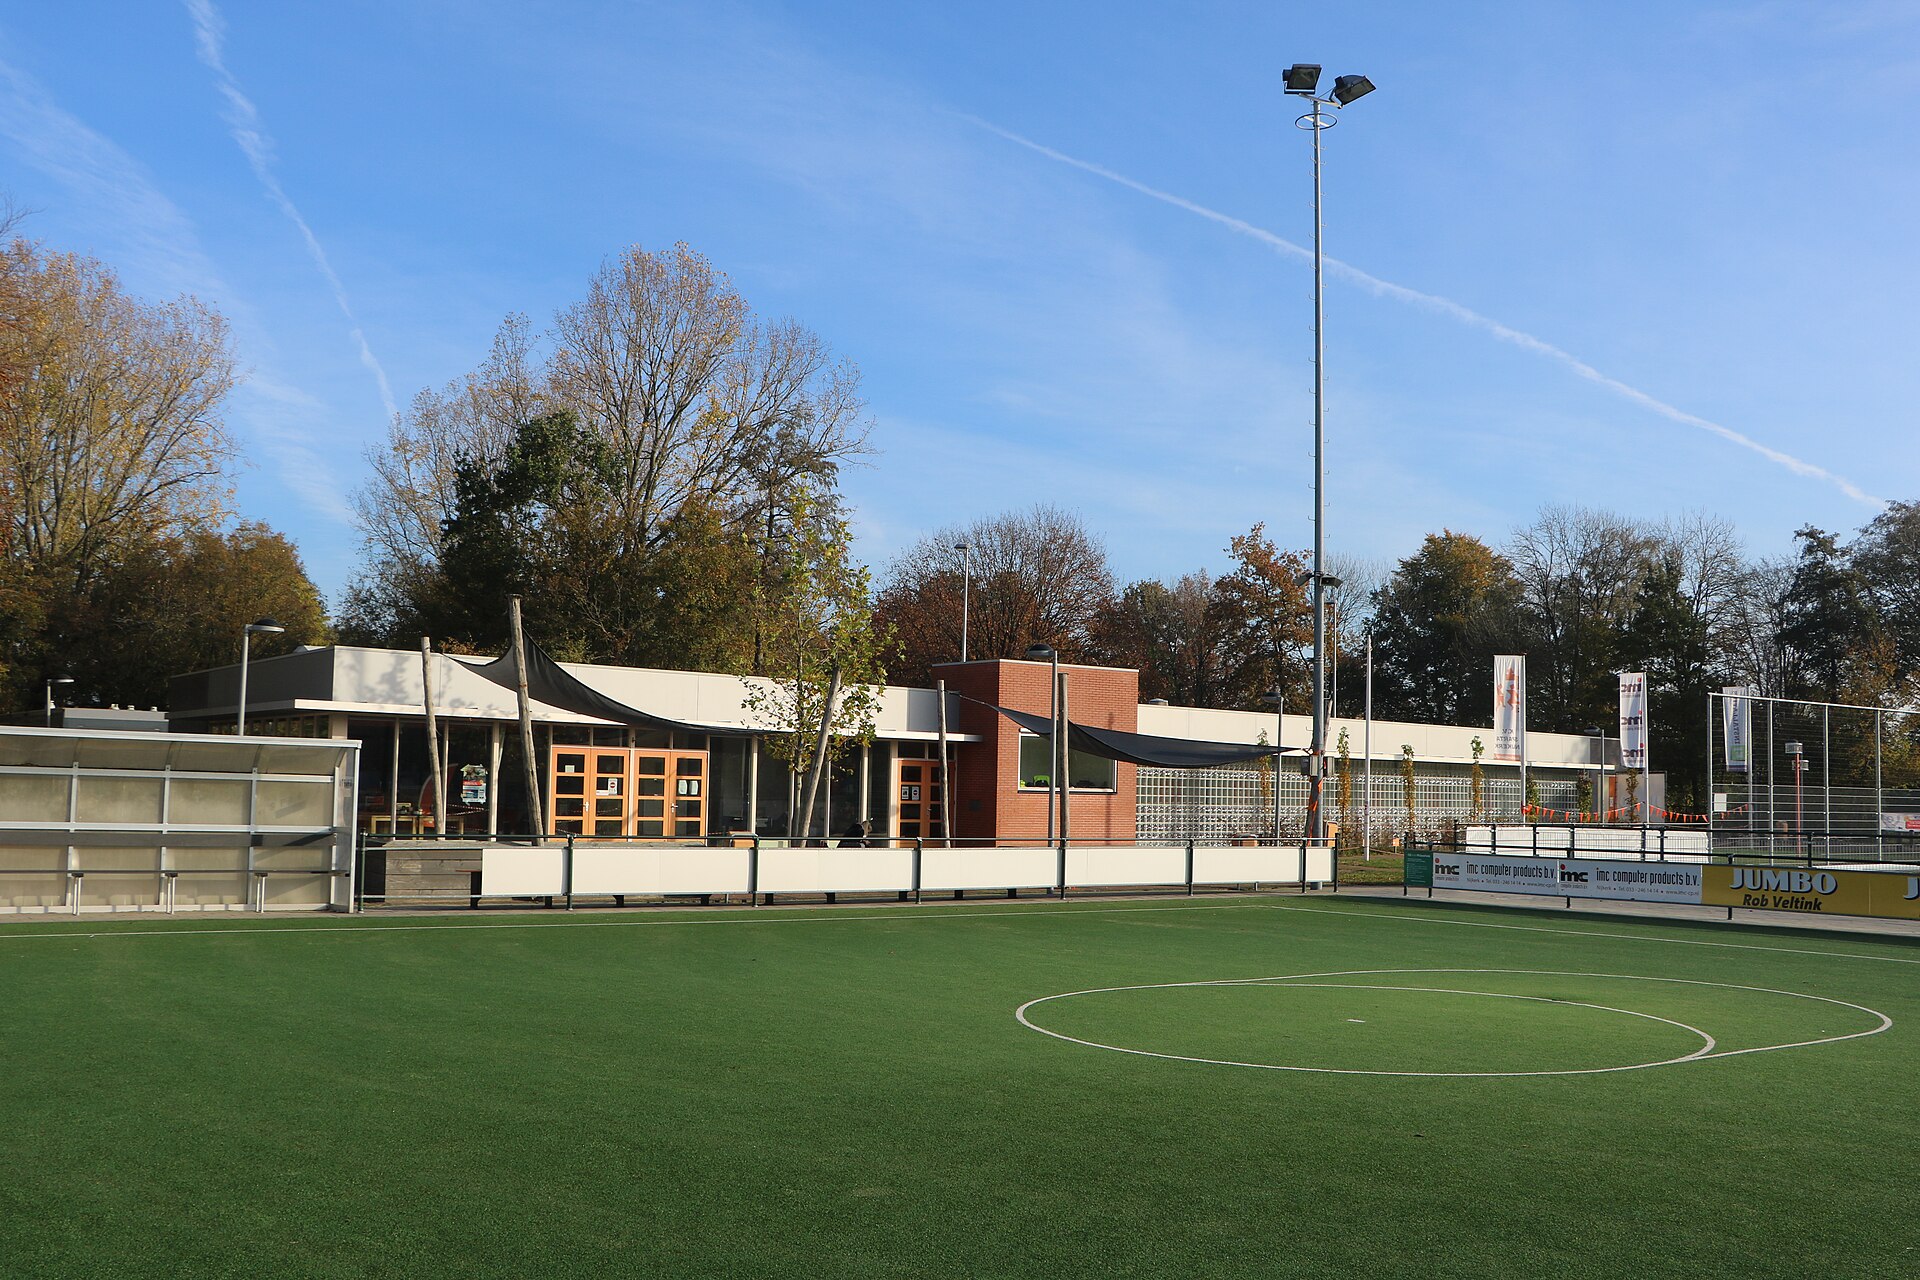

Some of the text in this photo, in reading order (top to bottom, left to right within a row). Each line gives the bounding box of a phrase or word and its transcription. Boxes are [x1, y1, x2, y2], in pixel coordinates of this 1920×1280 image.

[1435, 857, 1460, 875] imc
[1466, 861, 1557, 879] imc computer products b.v.
[1560, 863, 1588, 882] imc
[1596, 867, 1700, 886] imc computer products b.v.
[1730, 868, 1838, 895] JUMBO
[1742, 893, 1822, 911] Rob Veltink
